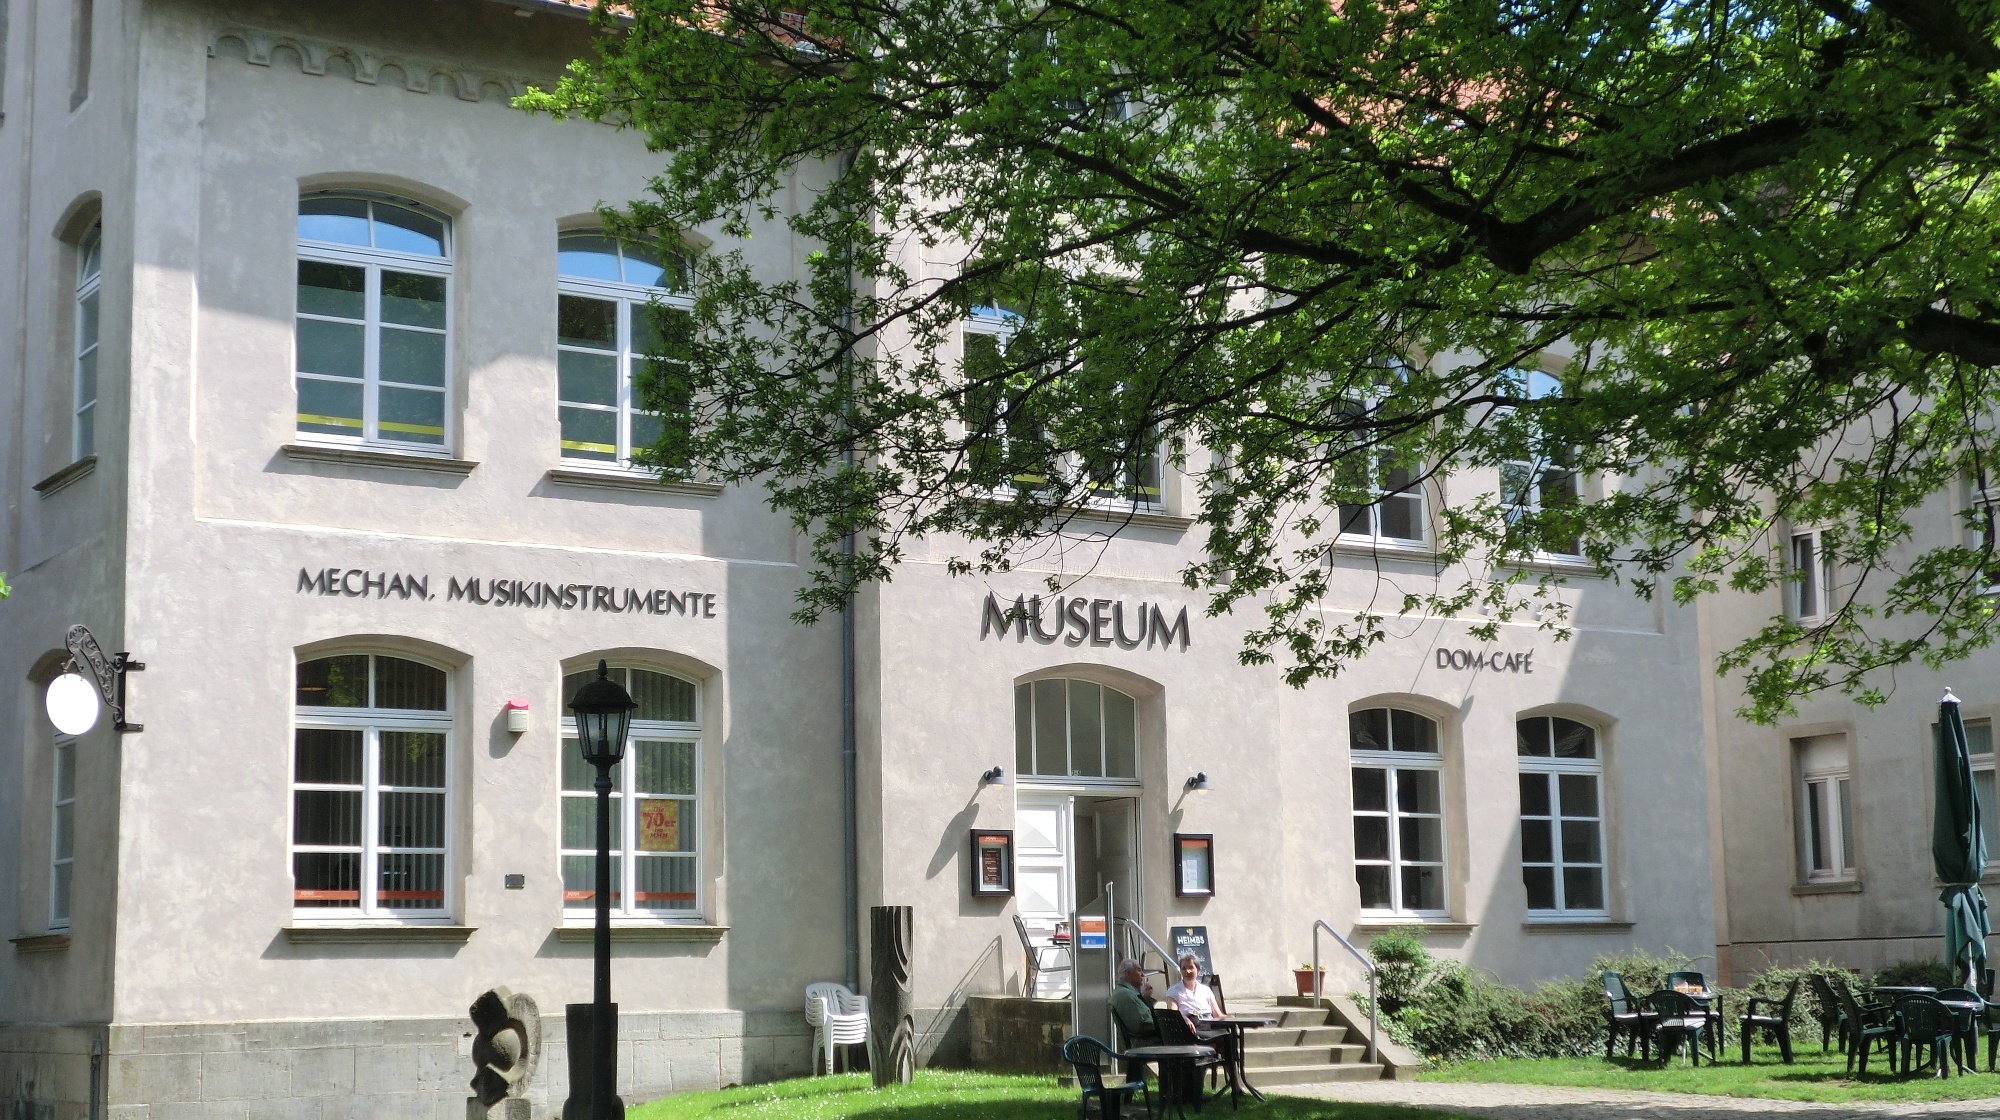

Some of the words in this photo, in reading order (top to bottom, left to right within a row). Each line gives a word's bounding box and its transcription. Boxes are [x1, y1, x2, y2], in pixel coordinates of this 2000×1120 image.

[447, 575, 717, 620] MUSIKINSTRUMENTE
[980, 590, 1191, 653] MUSEUM
[1436, 647, 1534, 674] DOM-CAFÉ
[642, 811, 676, 829] 70er
[1177, 936, 1205, 945] HEIMBS
